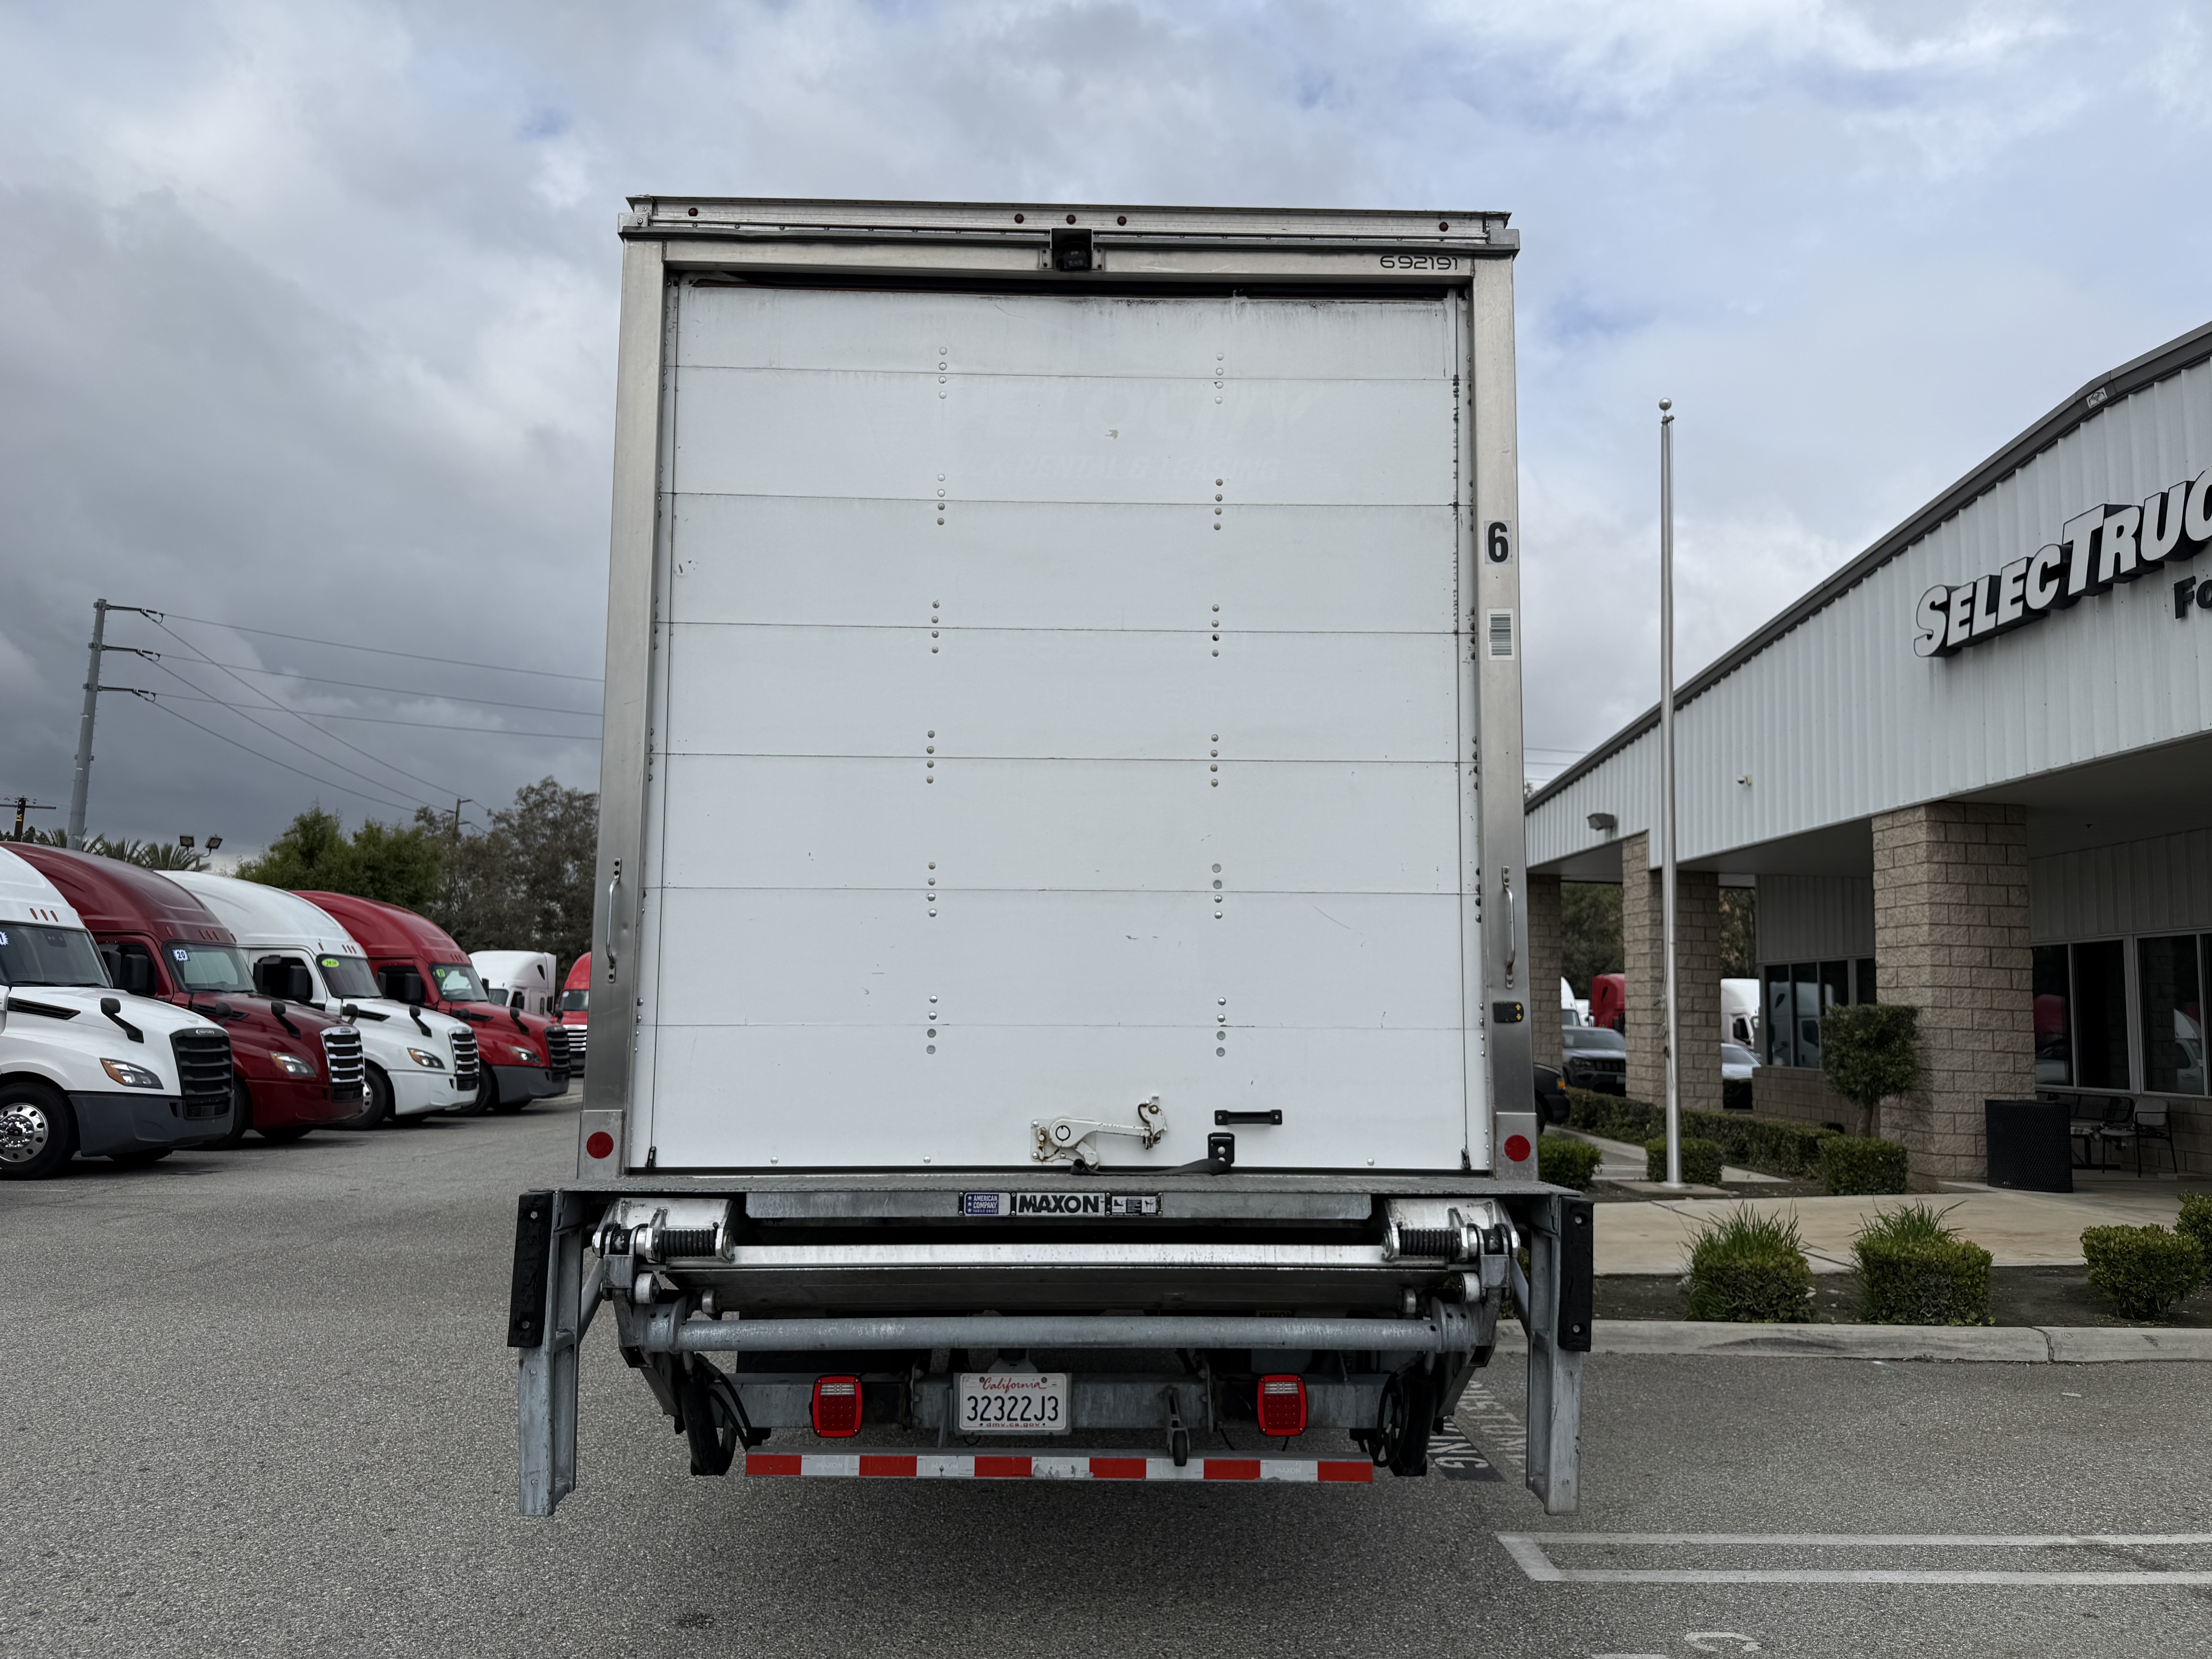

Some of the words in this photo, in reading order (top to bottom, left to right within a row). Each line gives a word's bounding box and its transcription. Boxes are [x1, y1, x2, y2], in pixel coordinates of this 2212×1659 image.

[1380, 256, 1457, 270] 692191
[1488, 522, 1508, 563] 6
[1018, 1195, 1099, 1213] MAXON
[982, 1377, 1047, 1393] California
[967, 1395, 1058, 1421] 32322J3
